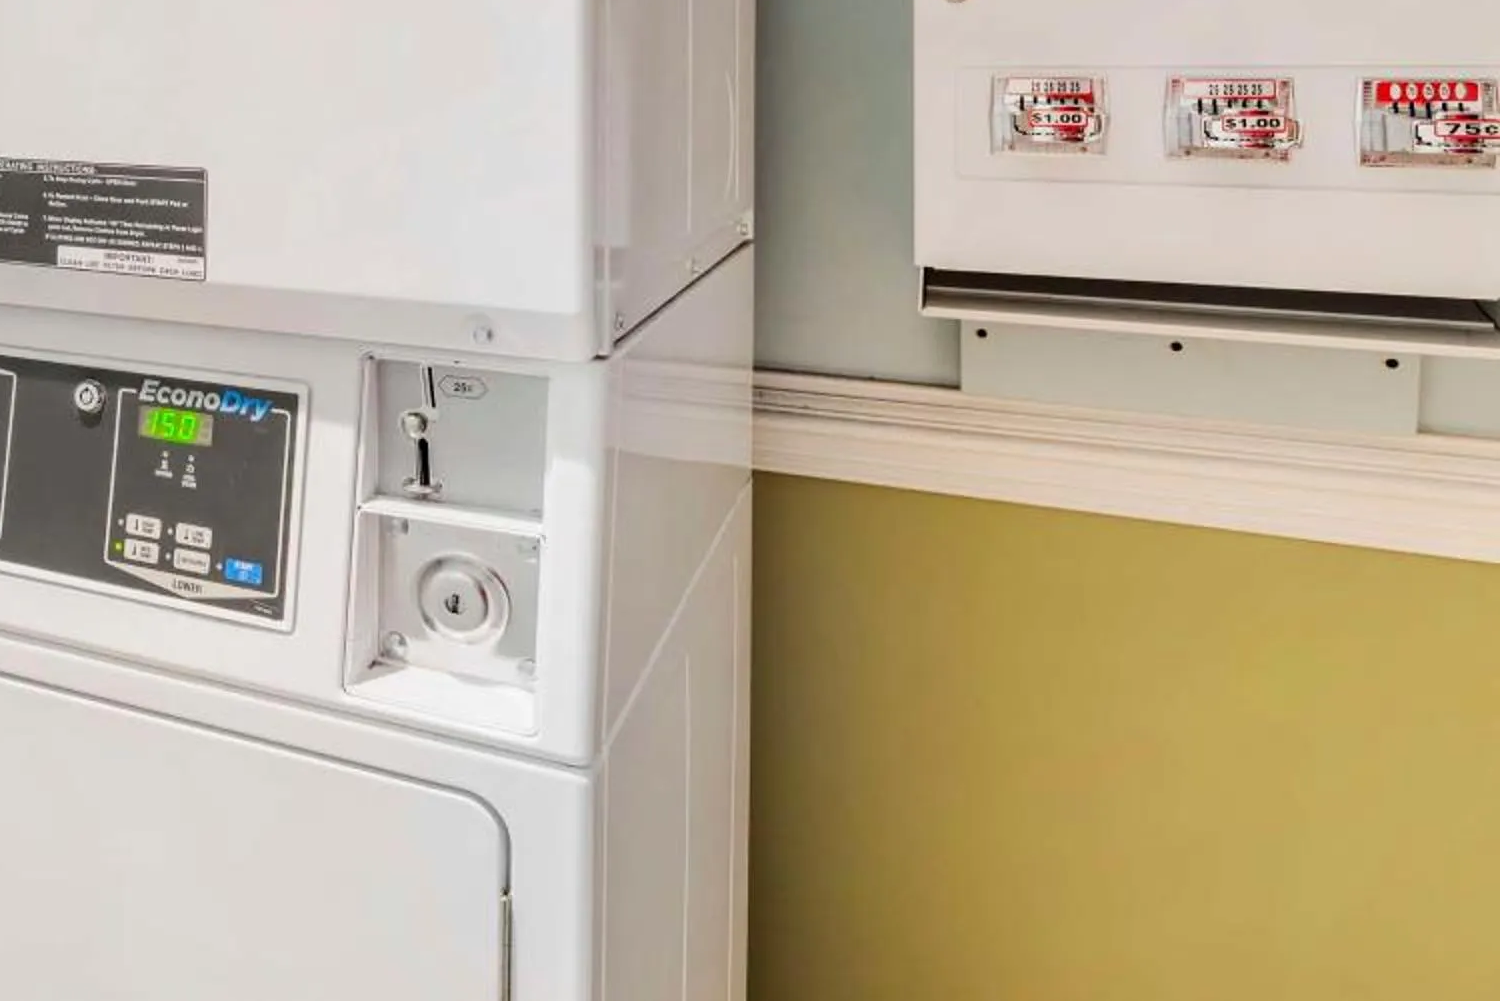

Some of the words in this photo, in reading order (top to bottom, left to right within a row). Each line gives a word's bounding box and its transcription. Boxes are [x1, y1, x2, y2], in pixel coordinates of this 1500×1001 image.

[1032, 113, 1082, 124] $1.00
[1225, 118, 1281, 129] $1.00
[138, 379, 273, 422] EconoDry
